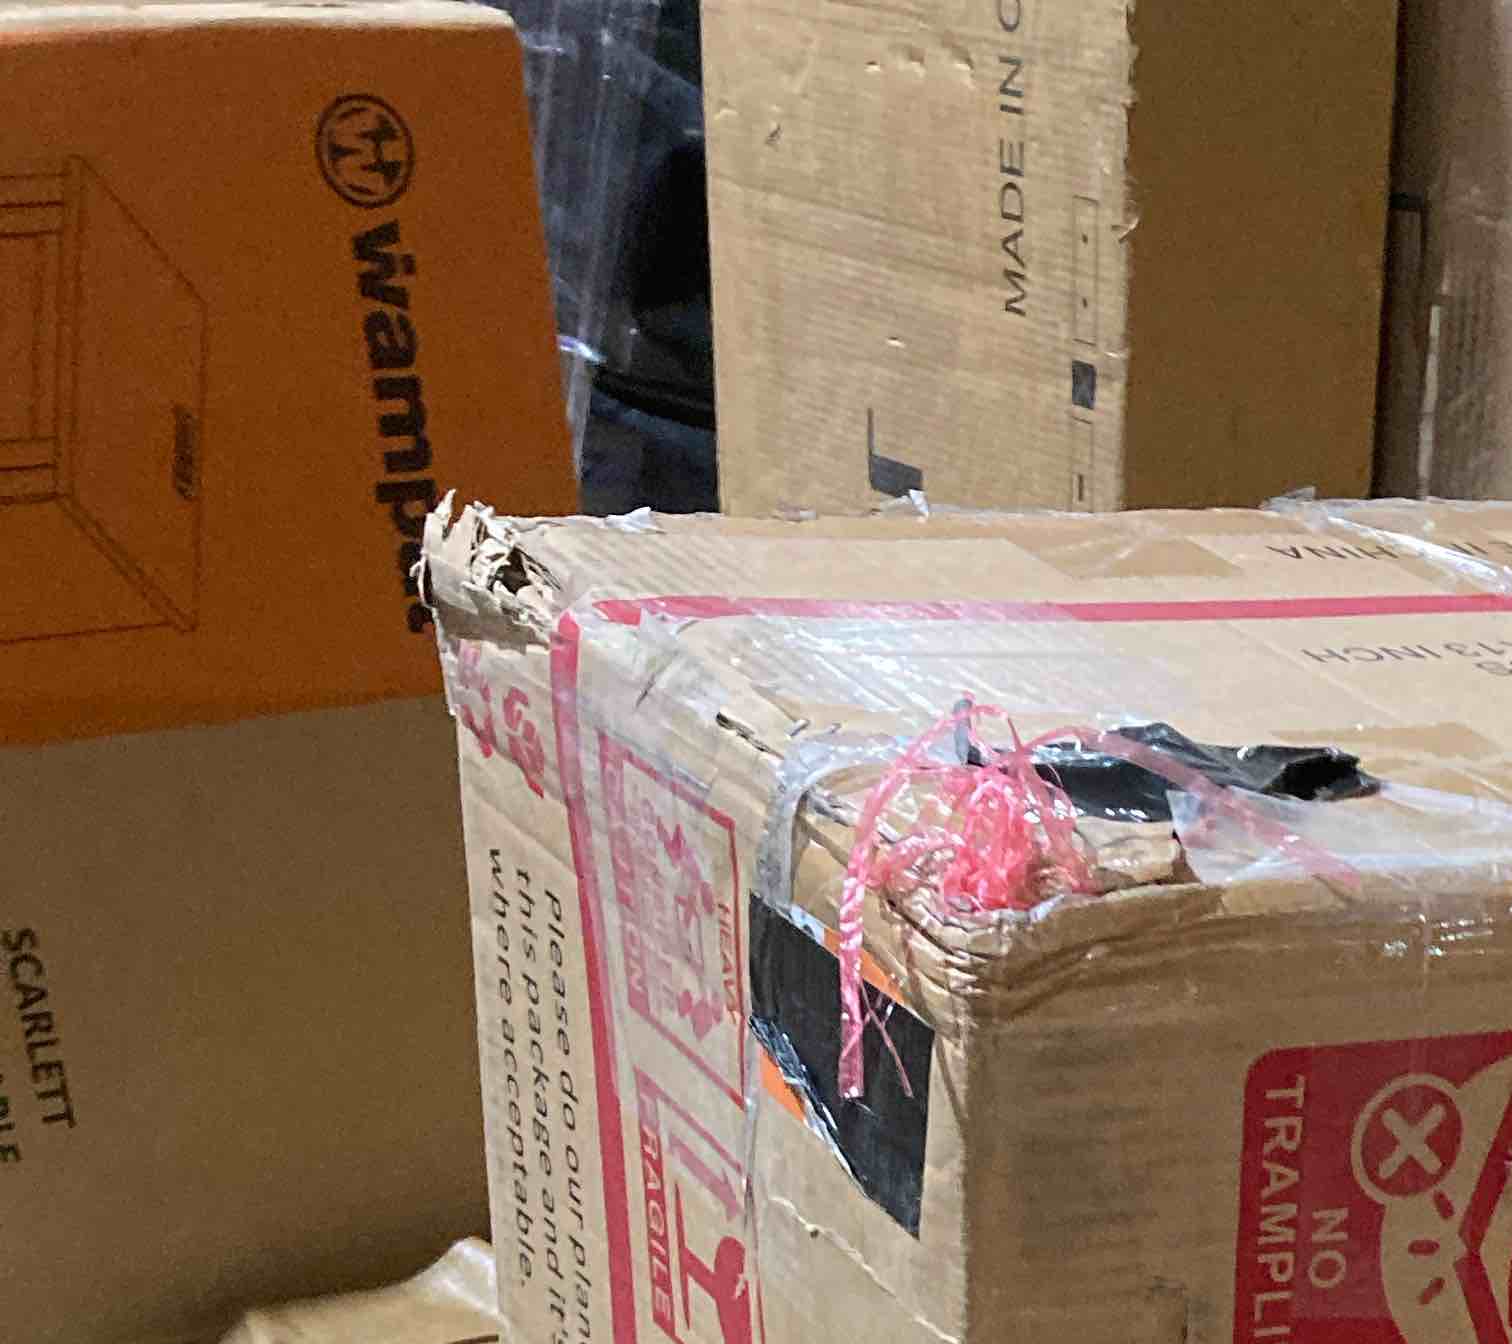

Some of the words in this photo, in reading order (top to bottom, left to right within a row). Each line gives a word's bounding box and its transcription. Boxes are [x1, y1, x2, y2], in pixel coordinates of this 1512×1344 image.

[999, 56, 1024, 114] IN
[1001, 142, 1027, 318] MADE
[1263, 543, 1405, 561] HINA
[1298, 643, 1440, 664] INCH
[487, 845, 515, 1005] where
[515, 867, 537, 961] this
[543, 888, 570, 1059] Please
[1, 927, 76, 1130] SCARLETT
[521, 971, 554, 1179] package
[559, 1069, 580, 1132] do
[499, 1016, 537, 1290] acceptable.
[566, 1143, 584, 1229] our
[540, 1186, 563, 1278] and
[639, 1092, 672, 1323] FRAGILE
[1305, 1204, 1349, 1292] NO
